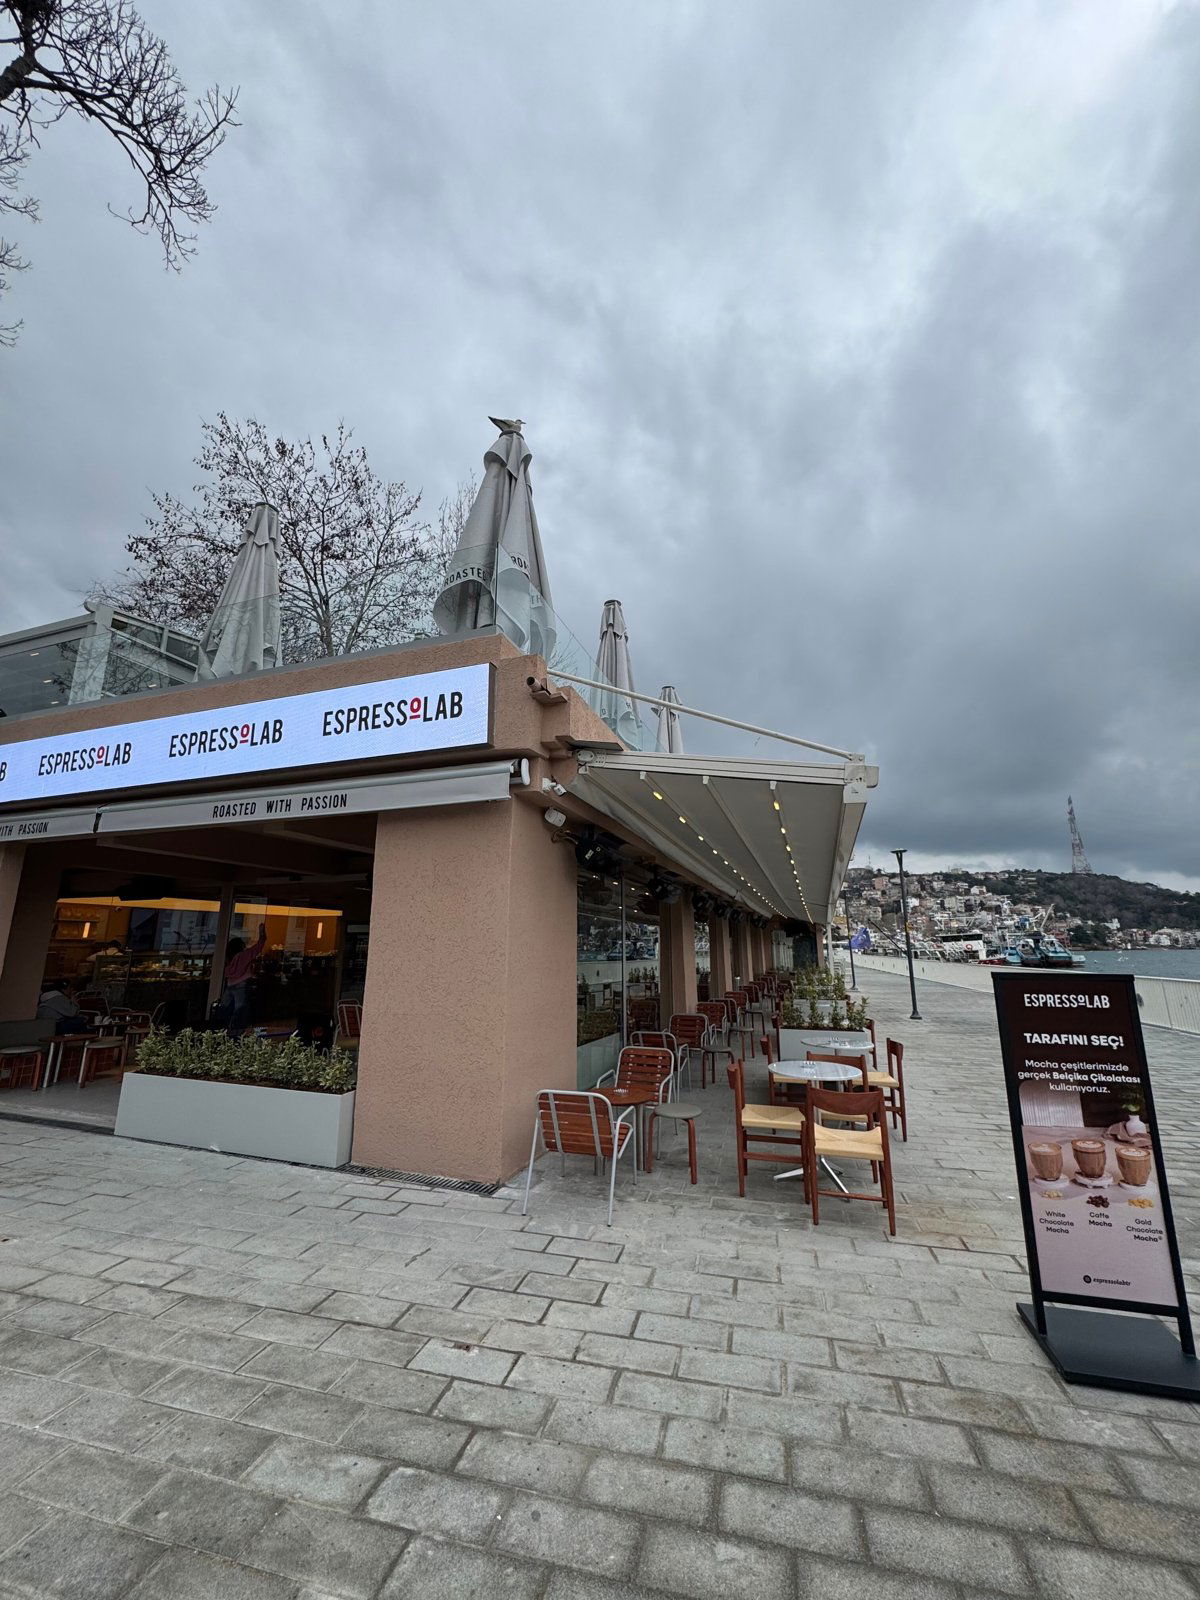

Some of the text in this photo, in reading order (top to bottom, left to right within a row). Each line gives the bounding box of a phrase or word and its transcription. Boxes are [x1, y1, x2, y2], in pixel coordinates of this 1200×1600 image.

[322, 691, 463, 737] ESPRESSOLAB
[168, 719, 284, 758] ESPRESSOLAB
[38, 742, 132, 776] ESPRESSOLAB
[212, 794, 348, 818] ROASTED WITH PASSION
[18, 822, 50, 835] PASSION
[1023, 993, 1110, 1009] ESPRESSOLAB
[1023, 1032, 1125, 1050] TARAFINI SEÇ!
[1025, 1059, 1129, 1072] Mocha çeşitlerimizde
[1017, 1071, 1141, 1084] gerçek Belçika Çikolatası
[1049, 1082, 1111, 1094] kullanıyoruz.
[1045, 1210, 1066, 1218] White
[1038, 1217, 1075, 1227] Chocolate
[1088, 1219, 1113, 1228] Mocha
[1134, 1218, 1153, 1226] Gold
[1045, 1226, 1070, 1234] Mocha
[1125, 1225, 1164, 1235] Chocolate
